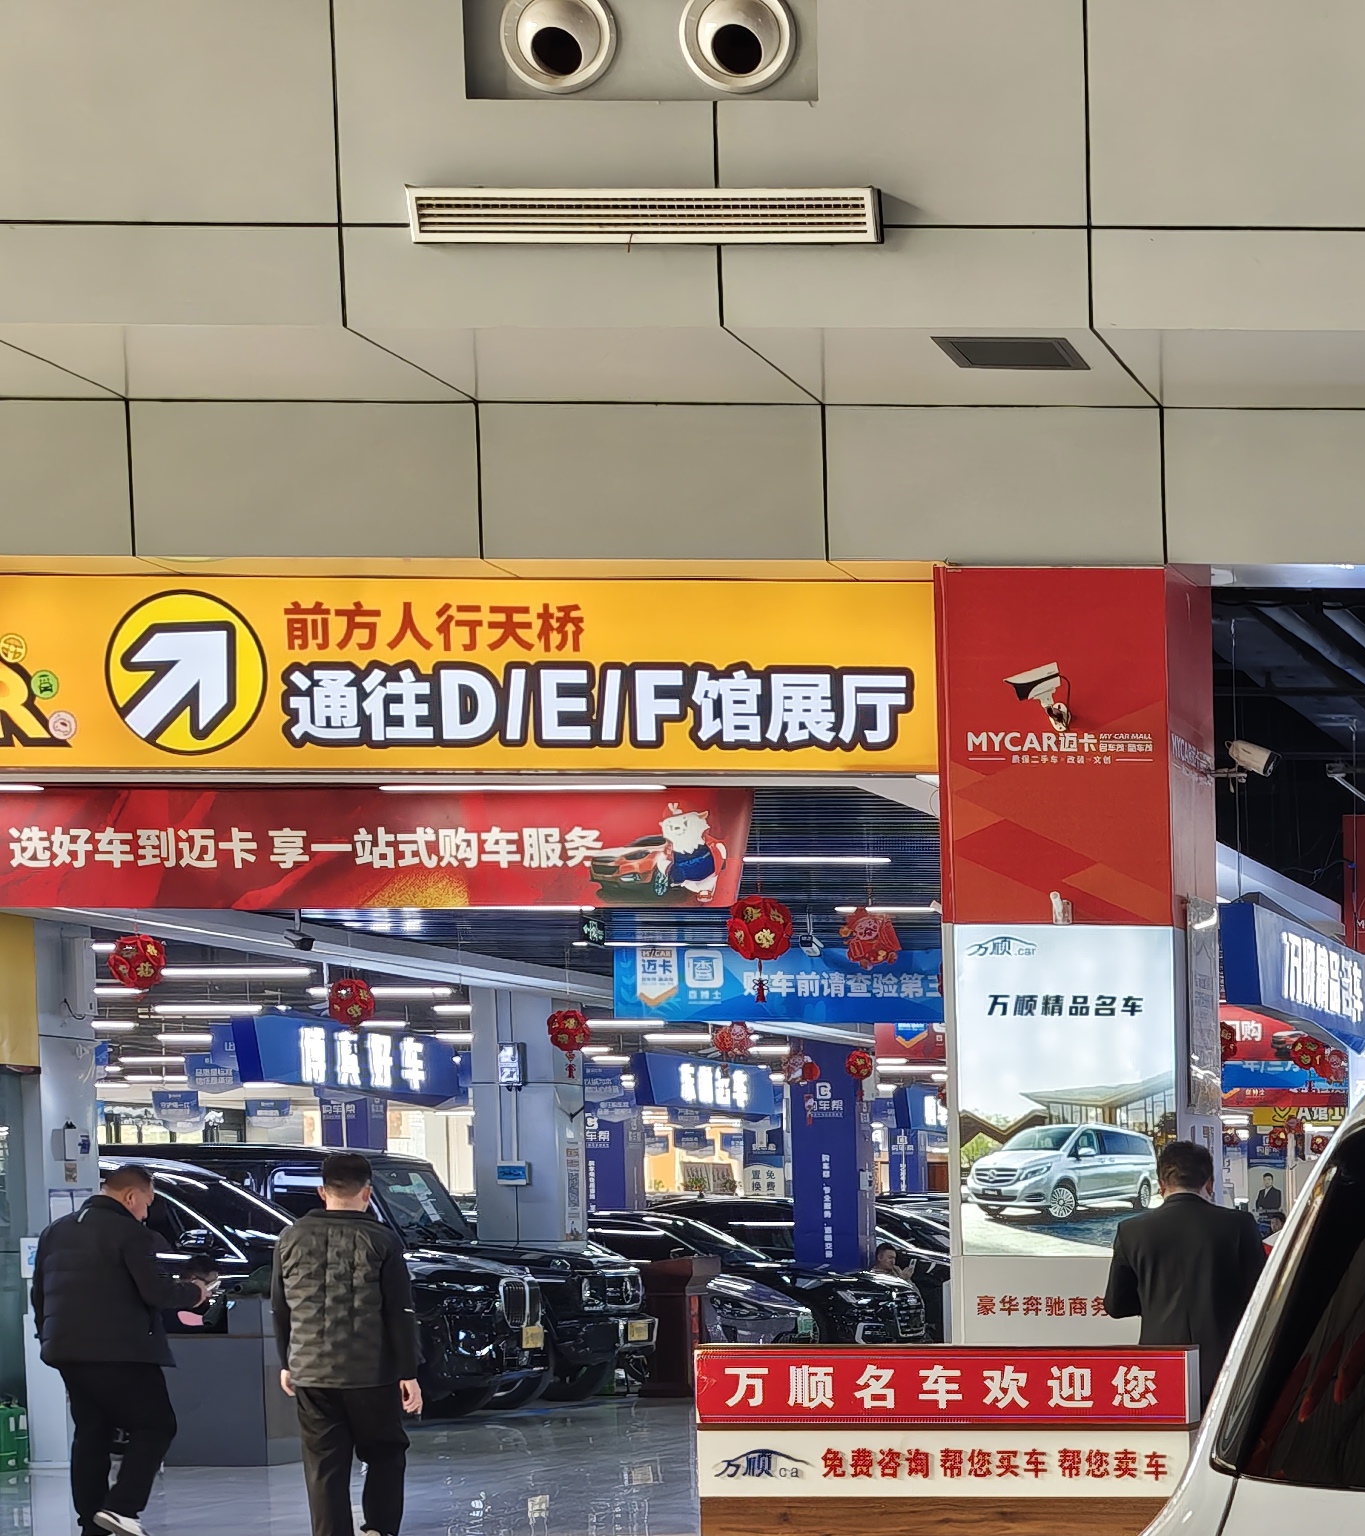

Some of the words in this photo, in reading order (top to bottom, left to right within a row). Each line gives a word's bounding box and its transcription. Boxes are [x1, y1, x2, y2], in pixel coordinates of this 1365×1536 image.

[283, 601, 586, 653] 前方人行天桥
[288, 665, 908, 746] 通往D/E/F馆展厅
[967, 731, 1097, 753] MYCAR迈卡
[9, 825, 259, 871] 选好车到迈卡
[269, 825, 605, 871] 享一站式购车服务
[641, 959, 673, 975] 迈卡
[987, 994, 1144, 1016] 万顺精品名车
[977, 1295, 1111, 1317] 豪华奔驰商务
[724, 1364, 1159, 1411] 万顺名车欢迎您
[820, 1446, 931, 1481] 免费咨询
[939, 1447, 1048, 1481] 帮您买车
[1057, 1448, 1170, 1482] 帮您卖车
